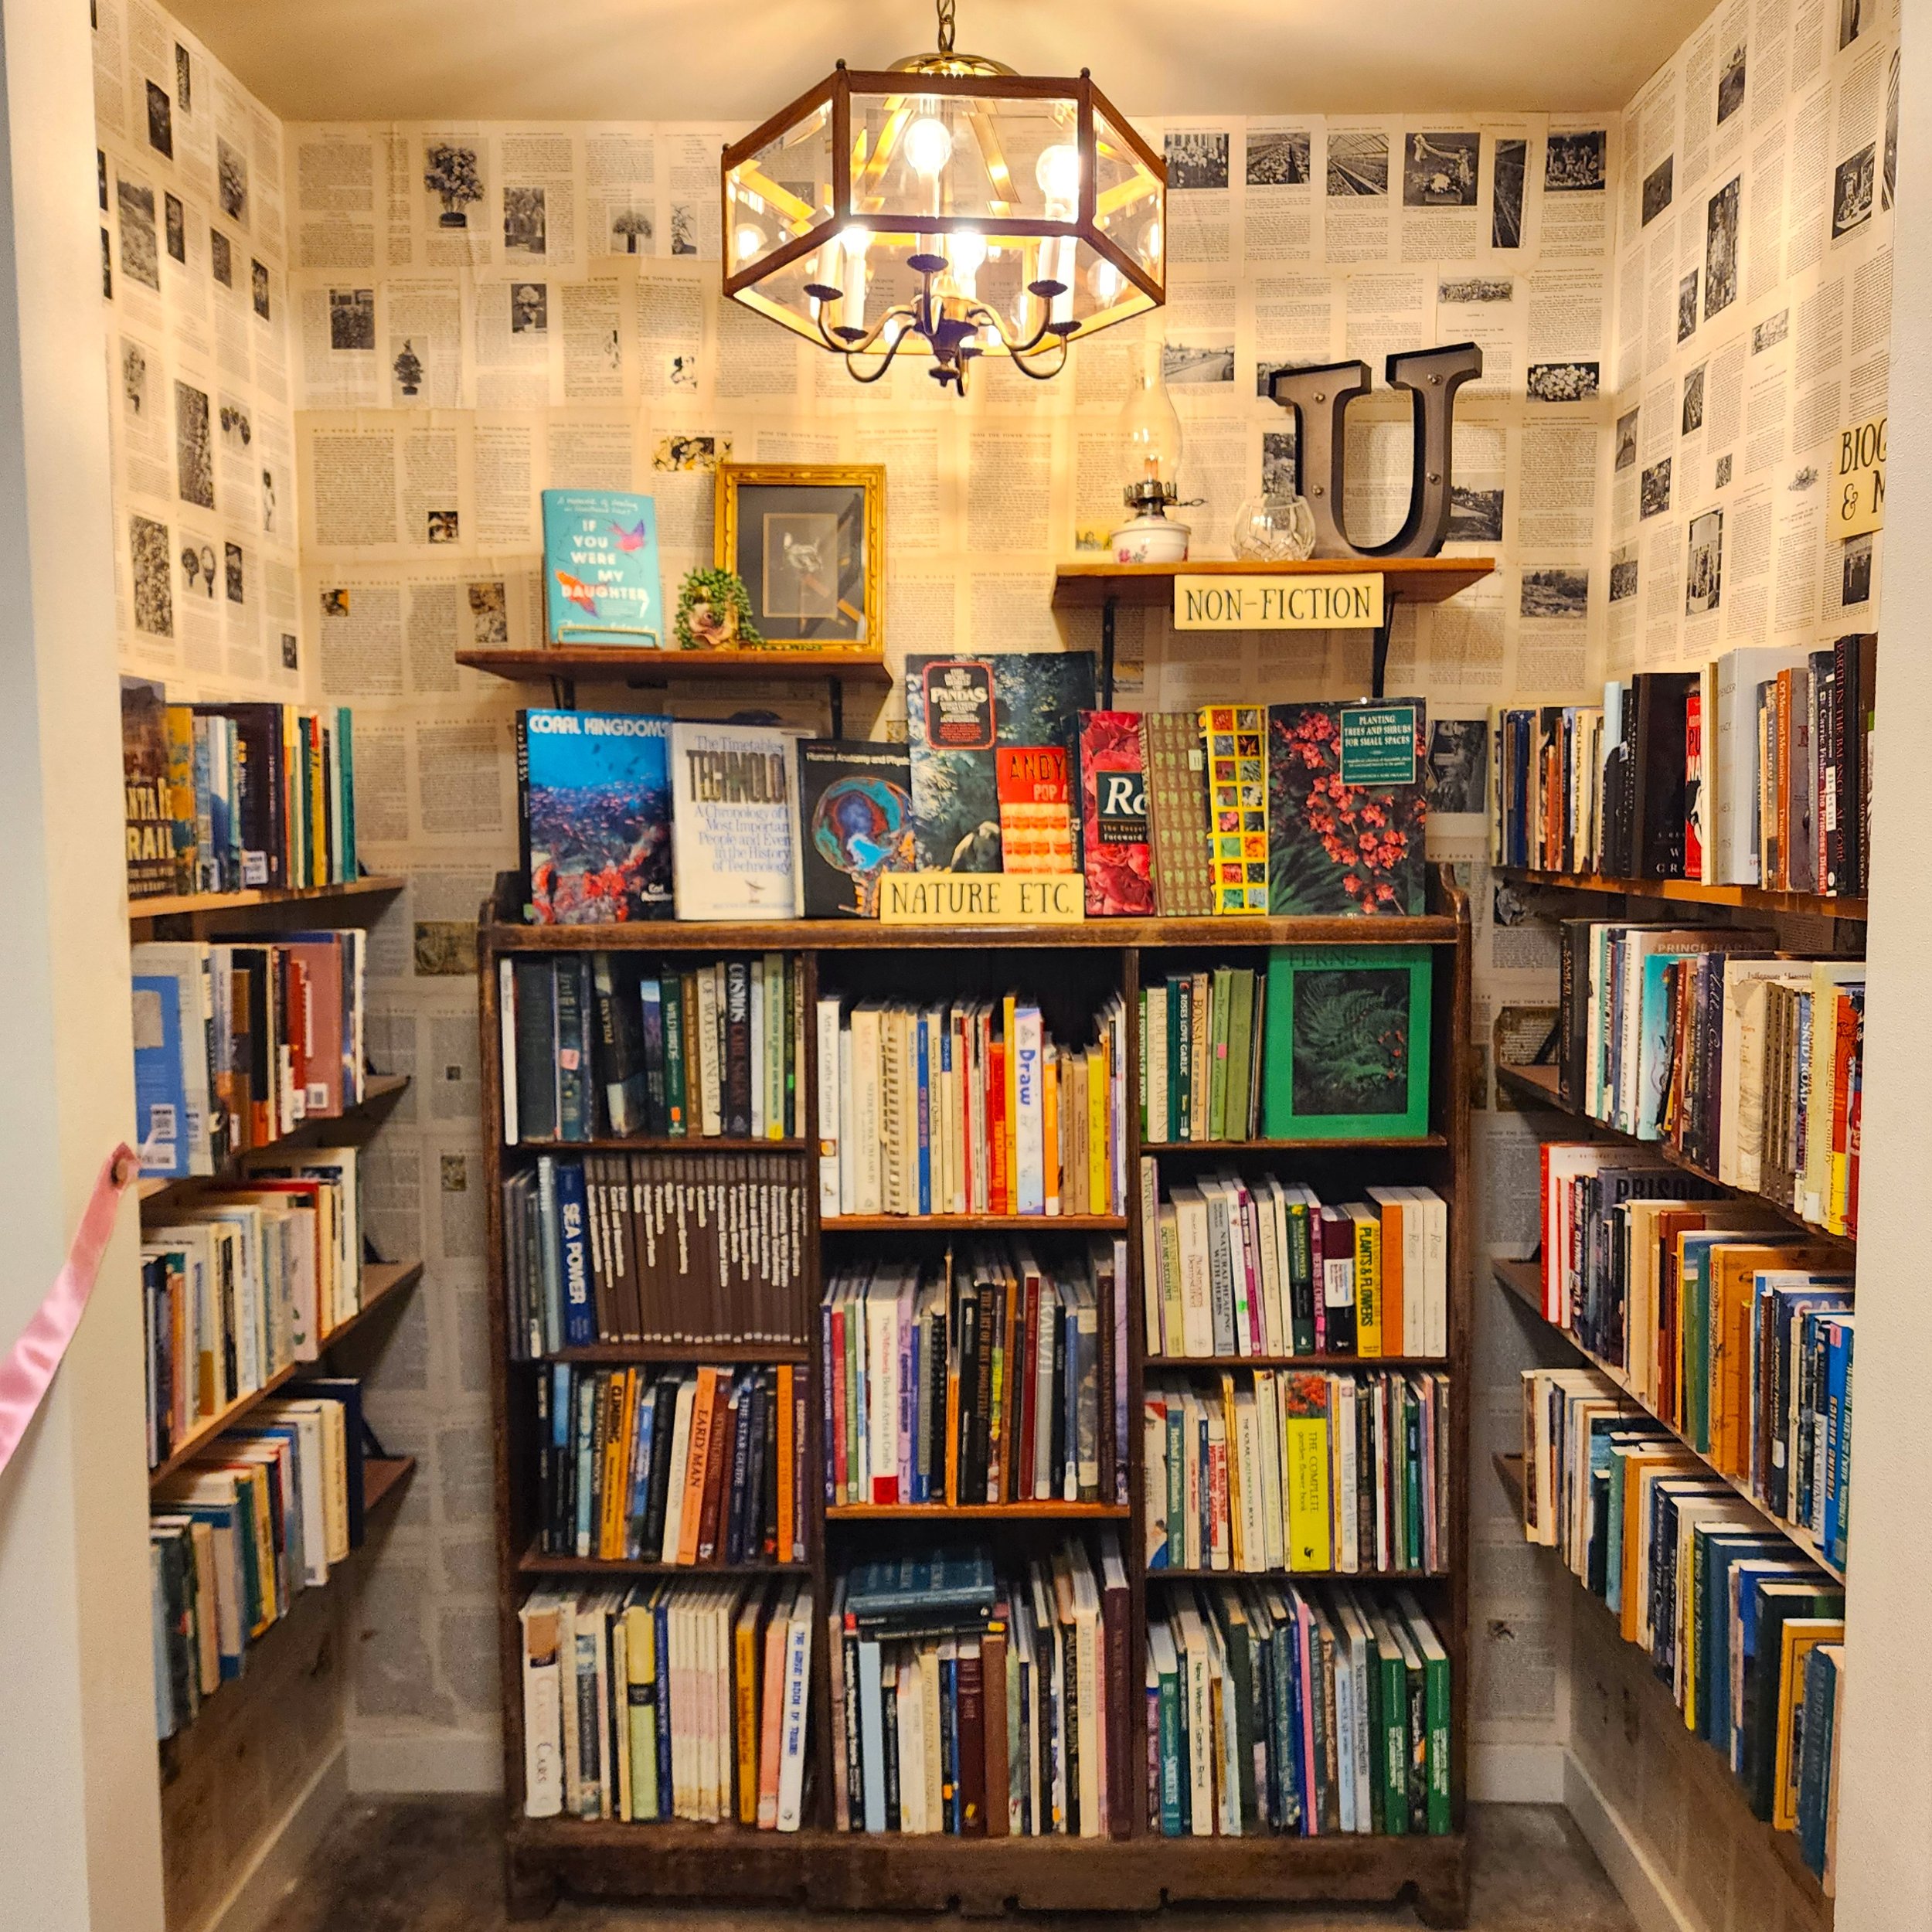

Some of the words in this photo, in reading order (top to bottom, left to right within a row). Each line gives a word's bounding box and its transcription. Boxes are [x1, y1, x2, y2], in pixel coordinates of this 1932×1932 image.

[1842, 483, 1859, 521] &
[583, 519, 597, 532] IF
[573, 535, 608, 548] YOU
[570, 551, 616, 565] WERE
[597, 570, 624, 583] MY
[561, 583, 649, 607] DAUGHTER
[1185, 586, 1371, 621] NON-FICTION
[1835, 643, 1845, 685] EARTH
[930, 687, 988, 703] PANDAS
[1835, 689, 1845, 703] IN
[529, 714, 581, 735] CORAL
[1344, 727, 1365, 736] TREES
[1366, 726, 1383, 735] AND
[1383, 725, 1412, 734] SHRUBS
[1359, 715, 1396, 725] PLANTING
[1818, 709, 1827, 745] Carrie
[1835, 708, 1845, 733] THE
[696, 736, 714, 750] The
[1345, 738, 1359, 747] FOR
[1360, 736, 1383, 747] SMALL
[1384, 736, 1410, 745] SPACES
[686, 750, 787, 804] TECHNOLO
[1010, 753, 1063, 781] ANDY
[1835, 740, 1845, 798] BALANCE
[1033, 784, 1057, 801] POP
[706, 805, 768, 821] Chronology
[706, 819, 732, 832] Most
[736, 819, 789, 834] Importan
[699, 833, 734, 847] People
[739, 834, 760, 846] and
[727, 847, 745, 859] the
[748, 846, 789, 862] History
[1836, 827, 1845, 863] GORE
[713, 860, 725, 872] of
[729, 860, 791, 876] Technology
[891, 883, 1001, 913] NATURE
[1018, 883, 1074, 913] ETC.
[1658, 943, 1706, 953] PRINCE
[702, 980, 713, 995] OF
[729, 963, 747, 1023] COSMOS
[1155, 994, 1167, 1019] FOR
[1179, 994, 1189, 1018] ROSES
[704, 1003, 716, 1053] WOLVES
[824, 1014, 833, 1032] Arts
[1179, 1020, 1189, 1043] LOVE
[1192, 999, 1204, 1047] BONSAI
[1155, 1024, 1167, 1073] BETTER
[1801, 1022, 1811, 1059] SKID
[706, 1056, 718, 1083] AND
[825, 1053, 834, 1082] Crafts
[1139, 1063, 1147, 1073] OF
[1179, 1044, 1189, 1077] GARLIC
[931, 1072, 940, 1103] Regional
[1019, 1049, 1036, 1106] Draw
[1800, 1063, 1811, 1105] ROAD
[1826, 1053, 1835, 1113] Bitterbrush
[825, 1085, 834, 1129] Furniture
[866, 1082, 875, 1140] NEEDLEWORK
[930, 1106, 939, 1137] Quilting
[1156, 1075, 1168, 1138] GARDENS
[992, 1121, 1005, 1187] handwriting
[1825, 1119, 1833, 1165] Country
[866, 1144, 876, 1184] TREASURY
[563, 1202, 580, 1240] SEA
[1162, 1247, 1170, 1260] AND
[1219, 1231, 1229, 1281] NATURAL
[1262, 1224, 1274, 1271] CACTUS
[1298, 1219, 1307, 1279] WILDFLOWERS
[1359, 1226, 1372, 1265] PLANTS
[1408, 1233, 1420, 1260] Roses
[1430, 1233, 1441, 1260] Roses
[566, 1242, 587, 1304] POWER
[1213, 1250, 1221, 1279] WITH
[1162, 1262, 1172, 1301] SUCCULENTS
[1187, 1254, 1197, 1308] Demystified
[1196, 1254, 1205, 1308] Mushrooms
[981, 1291, 991, 1306] THE
[1214, 1282, 1223, 1315] HERBS
[1223, 1284, 1232, 1333] HEALING
[1361, 1277, 1373, 1326] FLOWERS
[981, 1312, 991, 1329] ART
[981, 1332, 991, 1341] OF
[738, 1396, 750, 1419] THE
[883, 1400, 890, 1410] of
[883, 1411, 891, 1430] Arts
[1828, 1396, 1838, 1444] BASICS
[694, 1409, 709, 1449] EARLY
[736, 1421, 748, 1449] STAR
[1170, 1428, 1180, 1458] Herbal
[1309, 1432, 1318, 1452] THE
[883, 1442, 891, 1468] Crafts
[1298, 1432, 1306, 1460] garden
[689, 1453, 705, 1489] MAN
[734, 1451, 746, 1488] GUIDE
[1209, 1444, 1218, 1492] WEEKEND
[1298, 1463, 1308, 1488] flower
[1826, 1448, 1838, 1501] FISHING
[1170, 1462, 1180, 1513] Pathfinders
[1218, 1468, 1226, 1522] RELUCTANT
[1309, 1456, 1319, 1513] COMPLETE
[1299, 1492, 1308, 1512] book
[1209, 1496, 1218, 1547] GARDENER
[1080, 1626, 1091, 1657] SANTA
[1066, 1633, 1077, 1699] AUGUSTE
[1194, 1662, 1202, 1681] New
[1195, 1686, 1204, 1723] Western
[1067, 1702, 1079, 1754] RODIN
[1196, 1726, 1204, 1761] Garden
